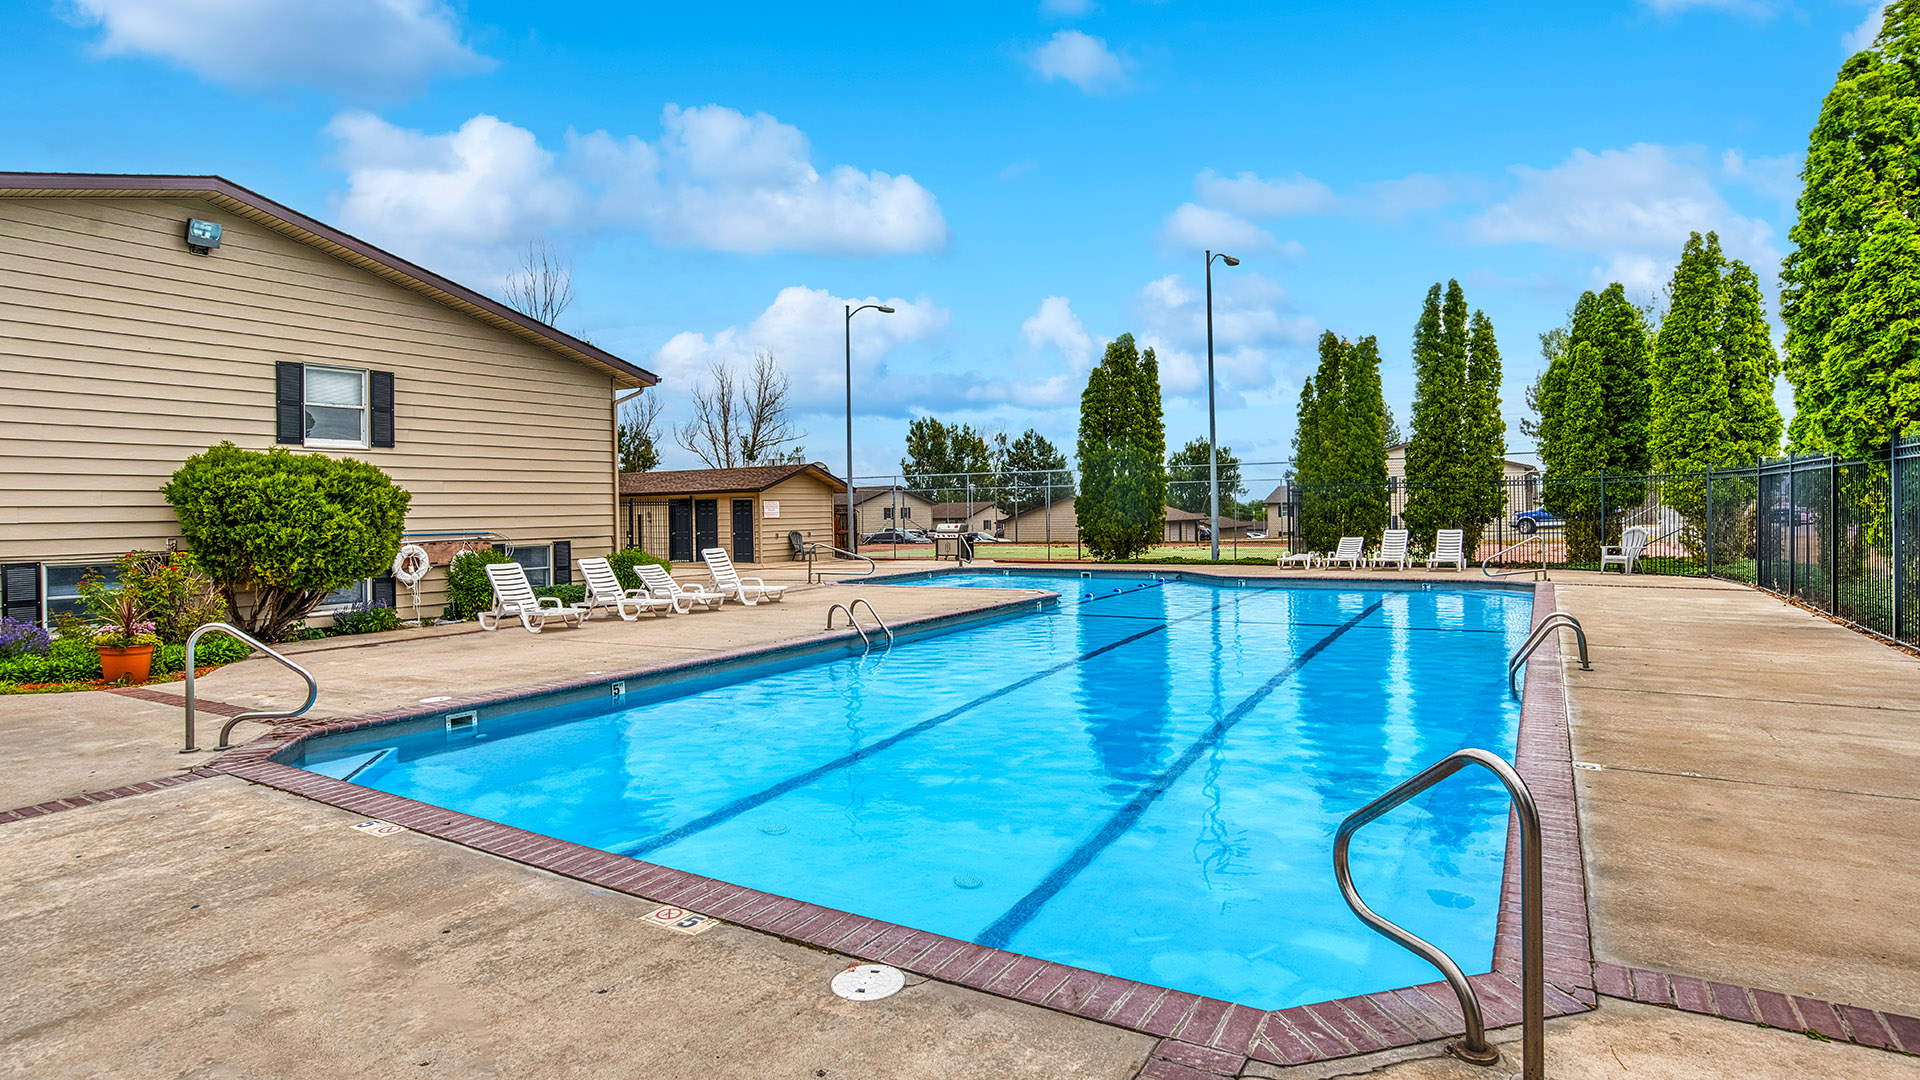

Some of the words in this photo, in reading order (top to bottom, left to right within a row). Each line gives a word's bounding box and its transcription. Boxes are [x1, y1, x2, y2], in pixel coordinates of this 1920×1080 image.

[613, 684, 620, 695] 5
[356, 820, 380, 828] 5
[677, 915, 705, 928] 5
